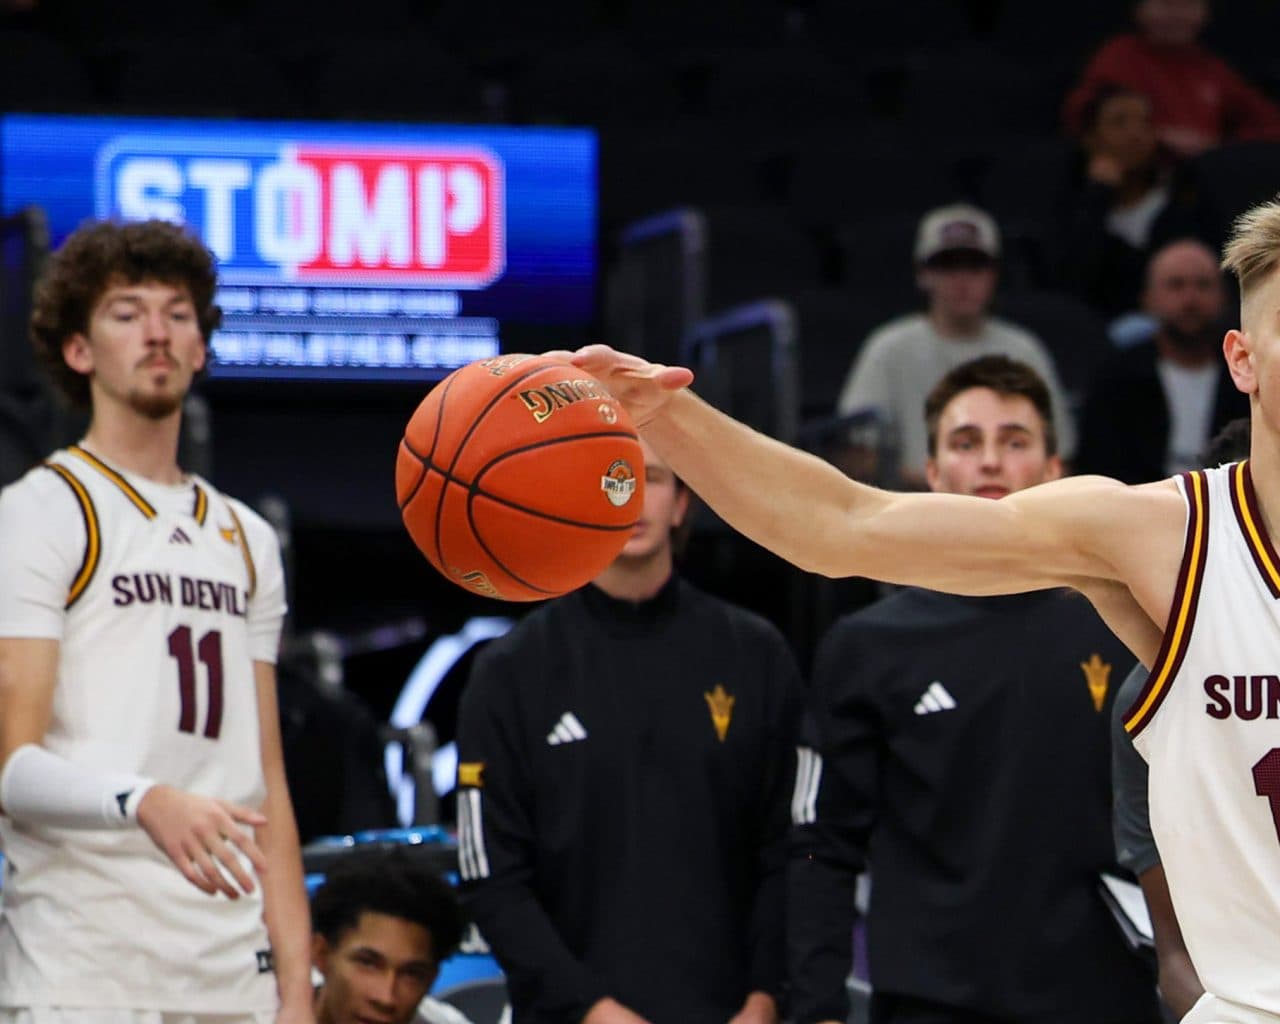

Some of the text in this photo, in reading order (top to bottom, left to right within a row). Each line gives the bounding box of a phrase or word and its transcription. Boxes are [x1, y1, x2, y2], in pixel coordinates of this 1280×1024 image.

[119, 157, 485, 267] STOMP
[112, 573, 249, 618] SUN DEVIL
[167, 624, 223, 739] 11
